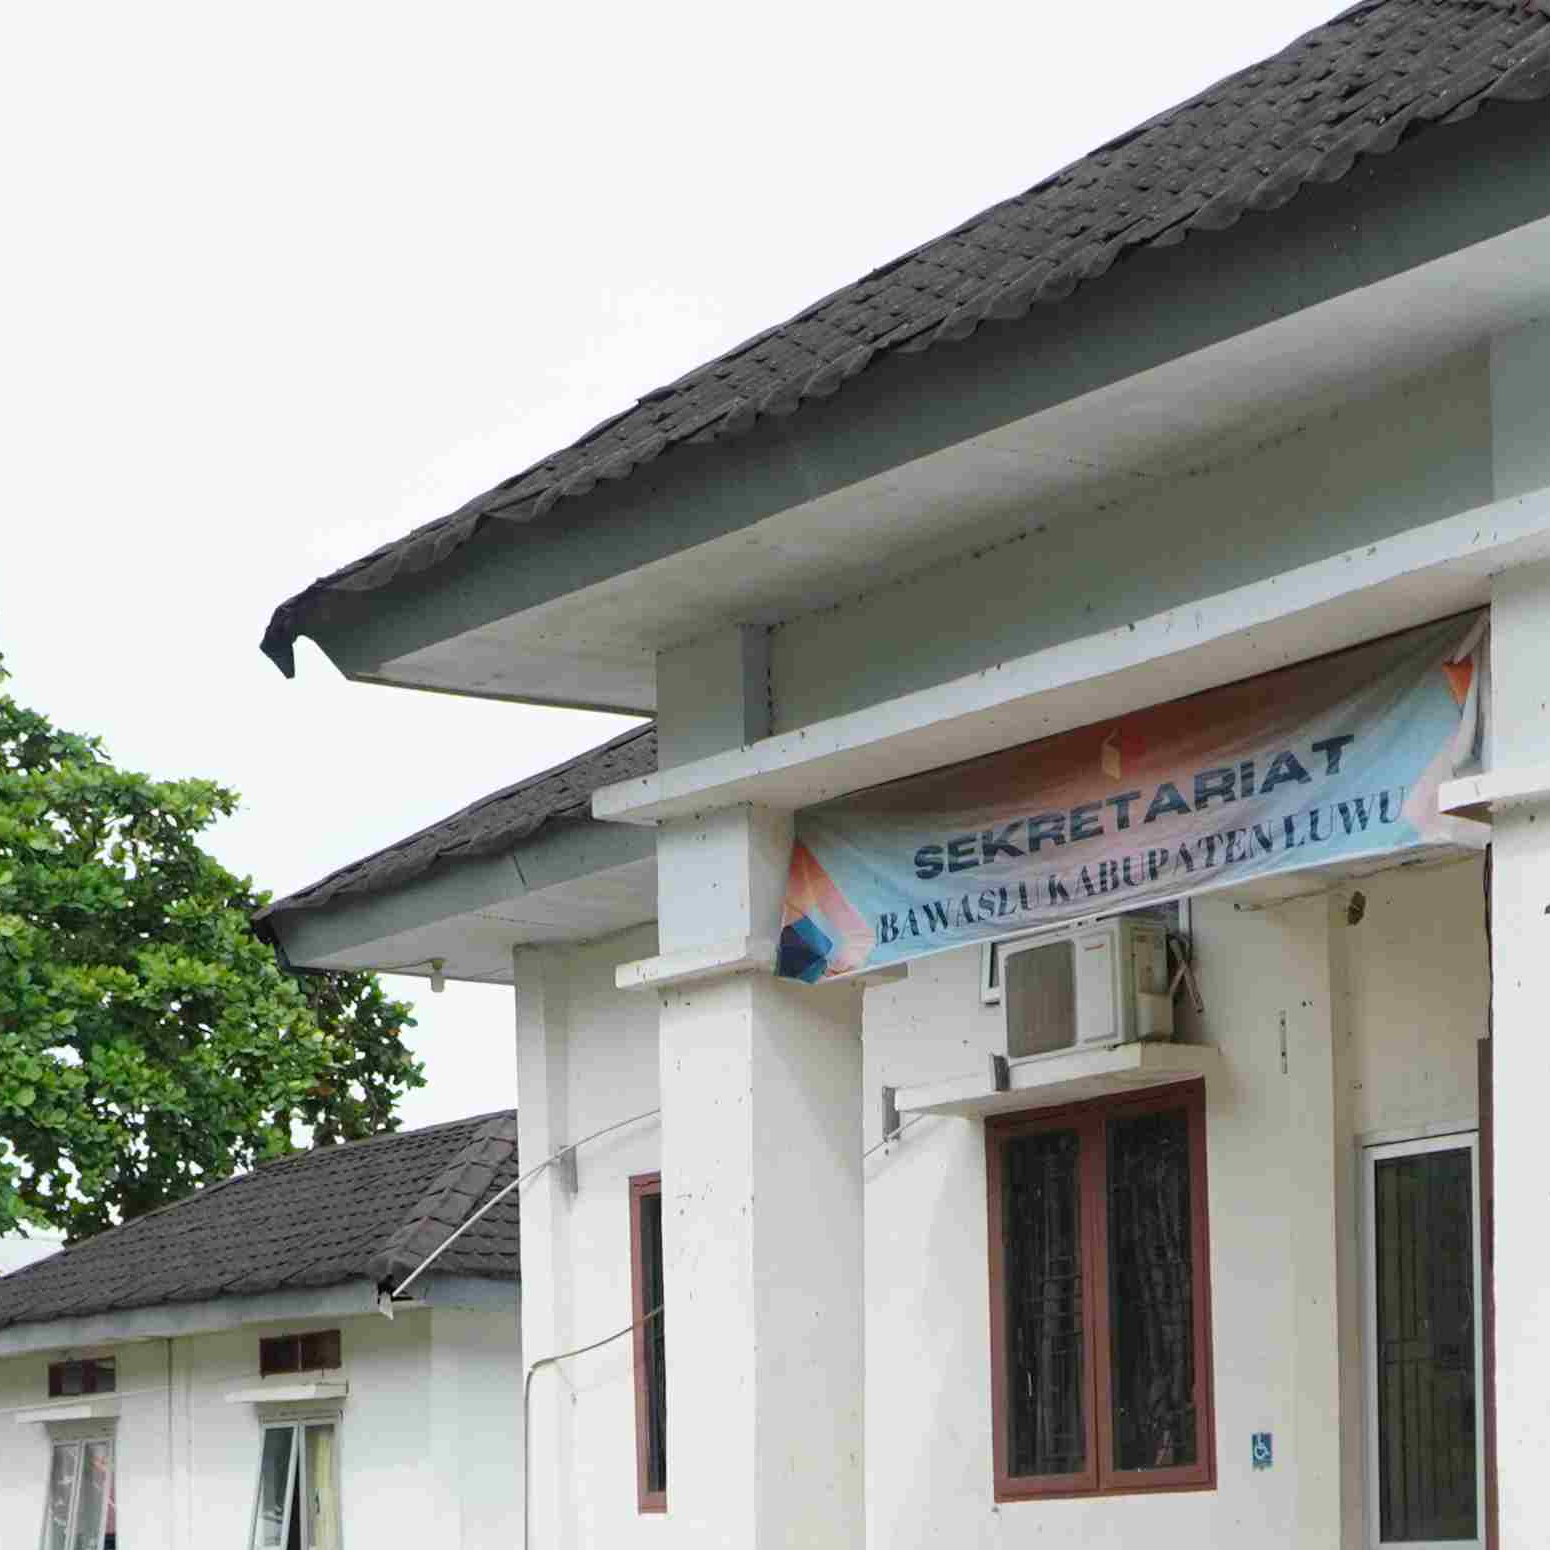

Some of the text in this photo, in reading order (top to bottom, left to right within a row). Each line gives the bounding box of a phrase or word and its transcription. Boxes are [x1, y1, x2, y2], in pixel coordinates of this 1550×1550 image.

[875, 786, 1406, 946] BAWASLU KABUPATEN LUWU
[913, 734, 1354, 880] SEKRETARIAT
